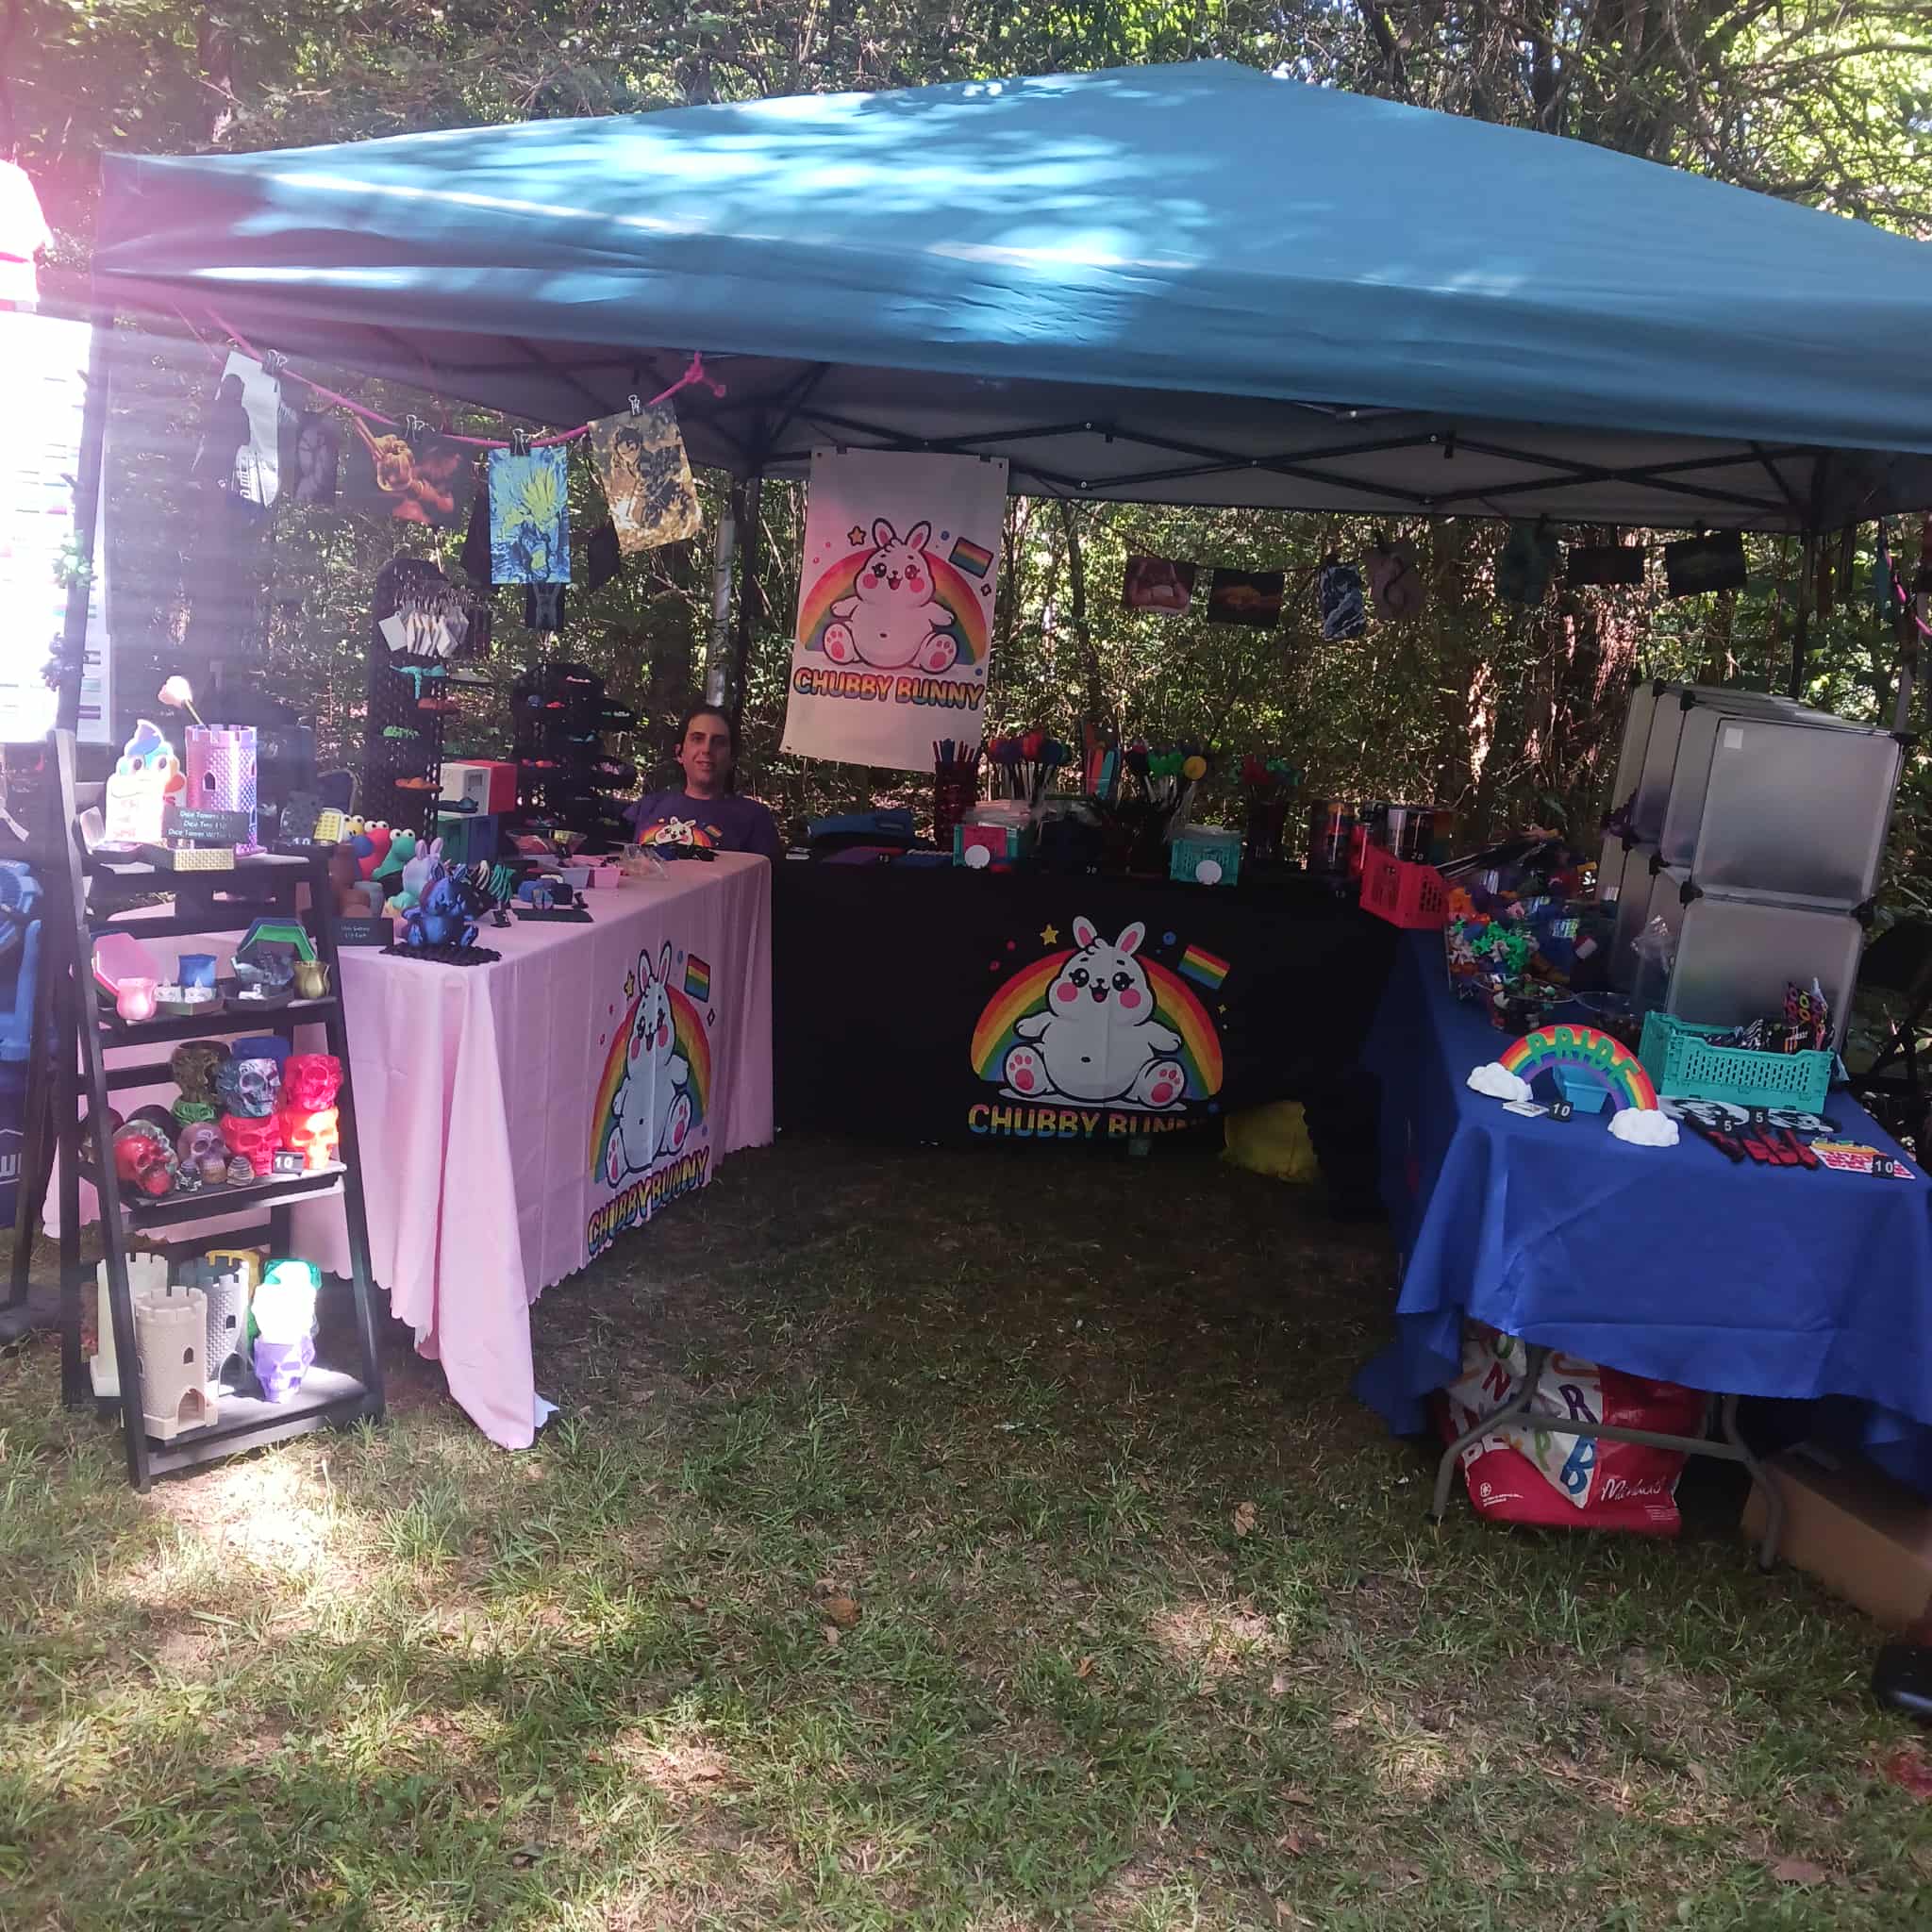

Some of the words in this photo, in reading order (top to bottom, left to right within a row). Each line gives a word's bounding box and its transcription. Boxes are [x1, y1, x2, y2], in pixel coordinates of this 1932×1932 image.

[793, 667, 893, 701] CHUBBY
[895, 675, 985, 710] BUNNY
[1525, 1026, 1641, 1089] PRIDE
[1553, 1104, 1571, 1117] 10
[1755, 1111, 1764, 1124] 5
[968, 1103, 1101, 1139] CHUBBY
[1724, 1120, 1733, 1132] 5
[275, 1156, 292, 1170] 10
[1875, 1160, 1894, 1174] 10
[588, 1177, 652, 1257] CHUBBY
[650, 1145, 710, 1212] BUNNY
